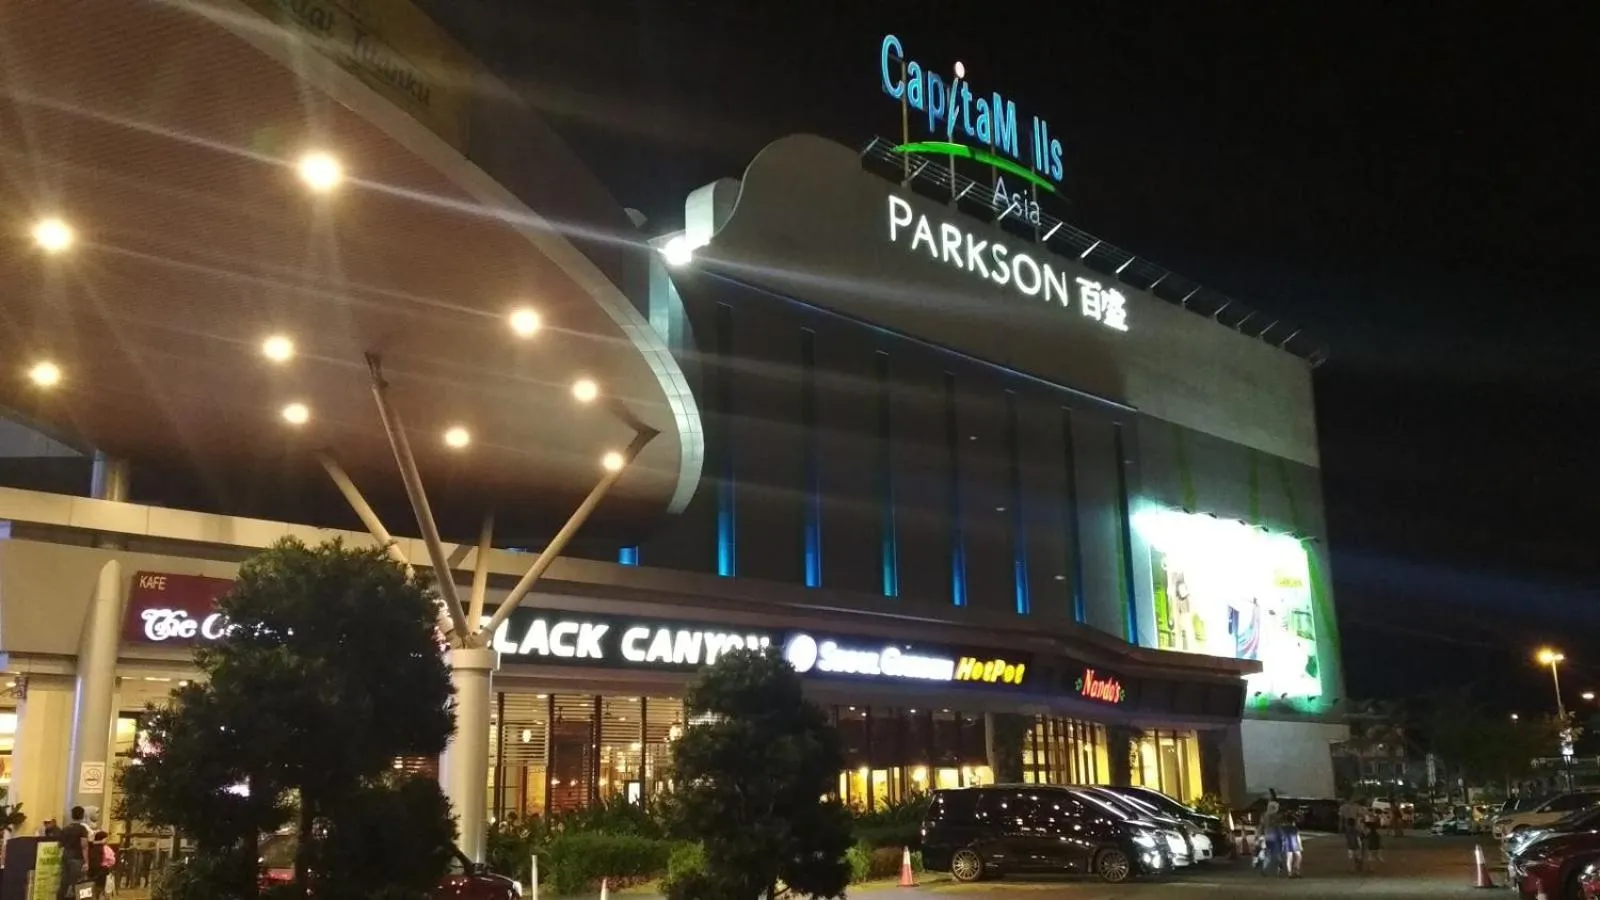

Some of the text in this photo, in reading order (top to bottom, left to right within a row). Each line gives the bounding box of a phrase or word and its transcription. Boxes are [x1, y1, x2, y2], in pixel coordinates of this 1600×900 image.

[880, 34, 1064, 182] CapitaMlls
[991, 176, 1042, 226] Asia
[887, 194, 1129, 332] PARKSON 百盛
[139, 575, 167, 591] KAFE
[141, 608, 199, 641] The
[479, 615, 609, 659] LACK
[957, 657, 1026, 685] HotPot
[1081, 668, 1121, 704] Nando's
